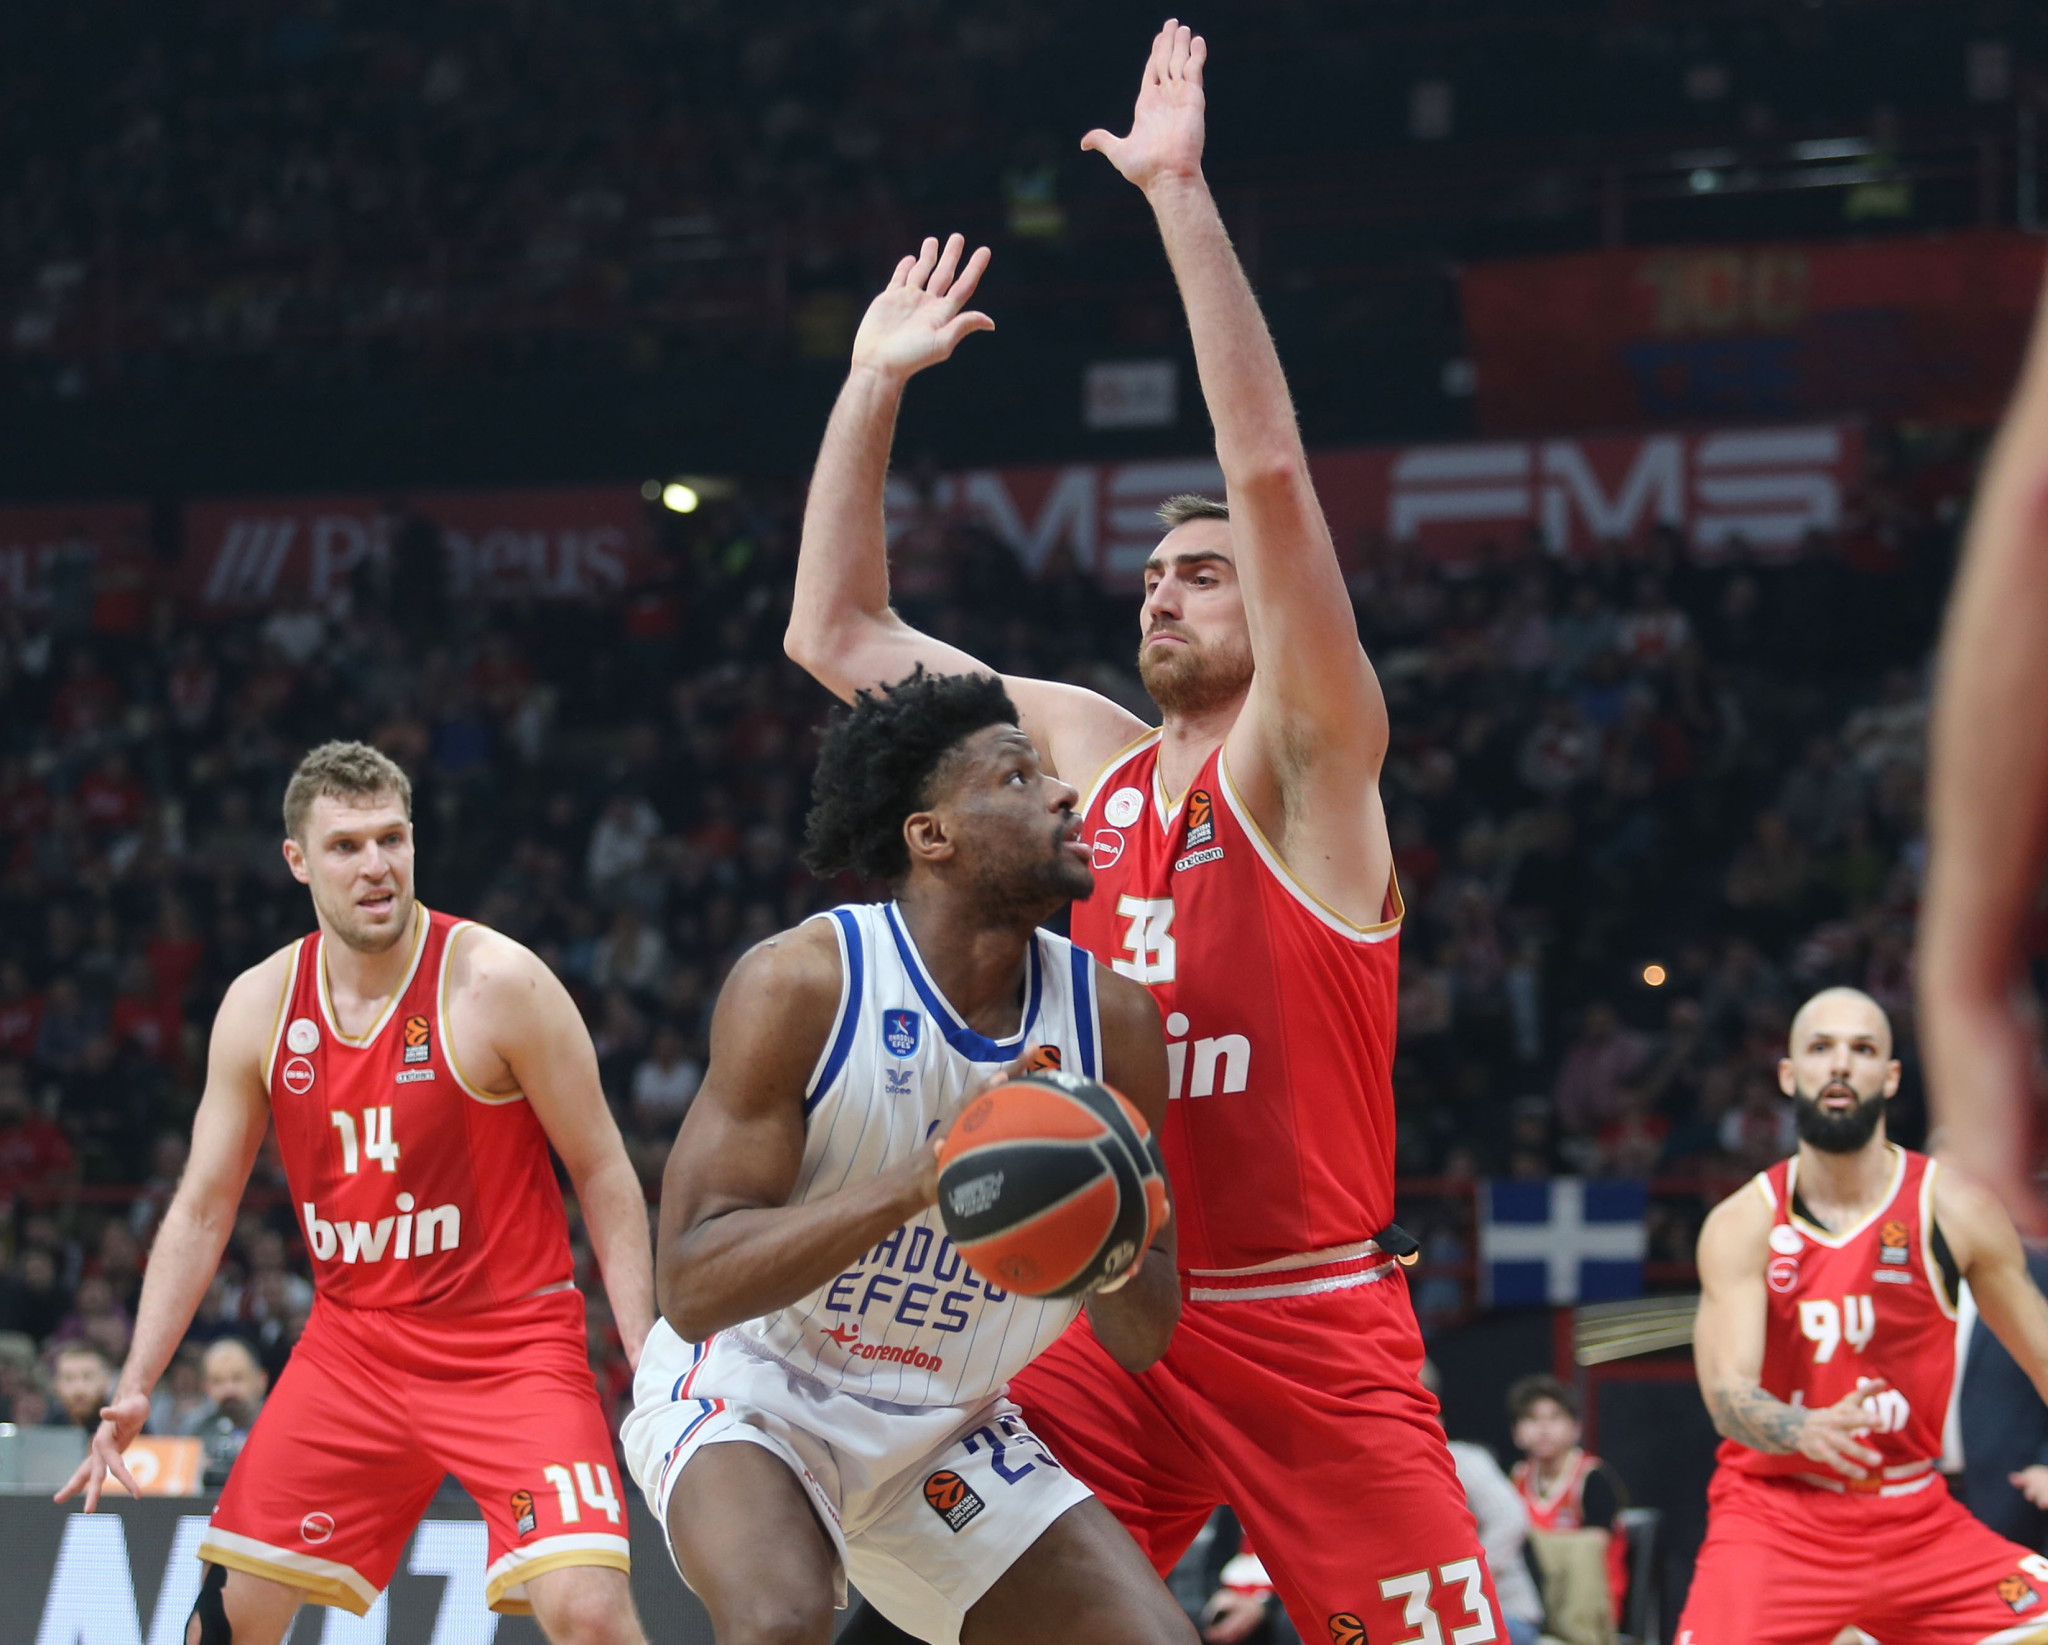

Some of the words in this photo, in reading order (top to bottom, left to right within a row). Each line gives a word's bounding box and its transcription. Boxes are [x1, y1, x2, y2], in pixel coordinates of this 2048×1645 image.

[1388, 427, 1842, 556] FMS
[1166, 1012, 1250, 1099] in
[331, 1106, 400, 1175] 14
[303, 1192, 461, 1264] bwin
[825, 1271, 974, 1333] EFES
[849, 1343, 943, 1372] corendon
[543, 1462, 620, 1524] 14
[946, 1493, 975, 1519] TURKISH
[950, 1498, 978, 1525] AIRLINES
[1378, 1557, 1497, 1645] 33
